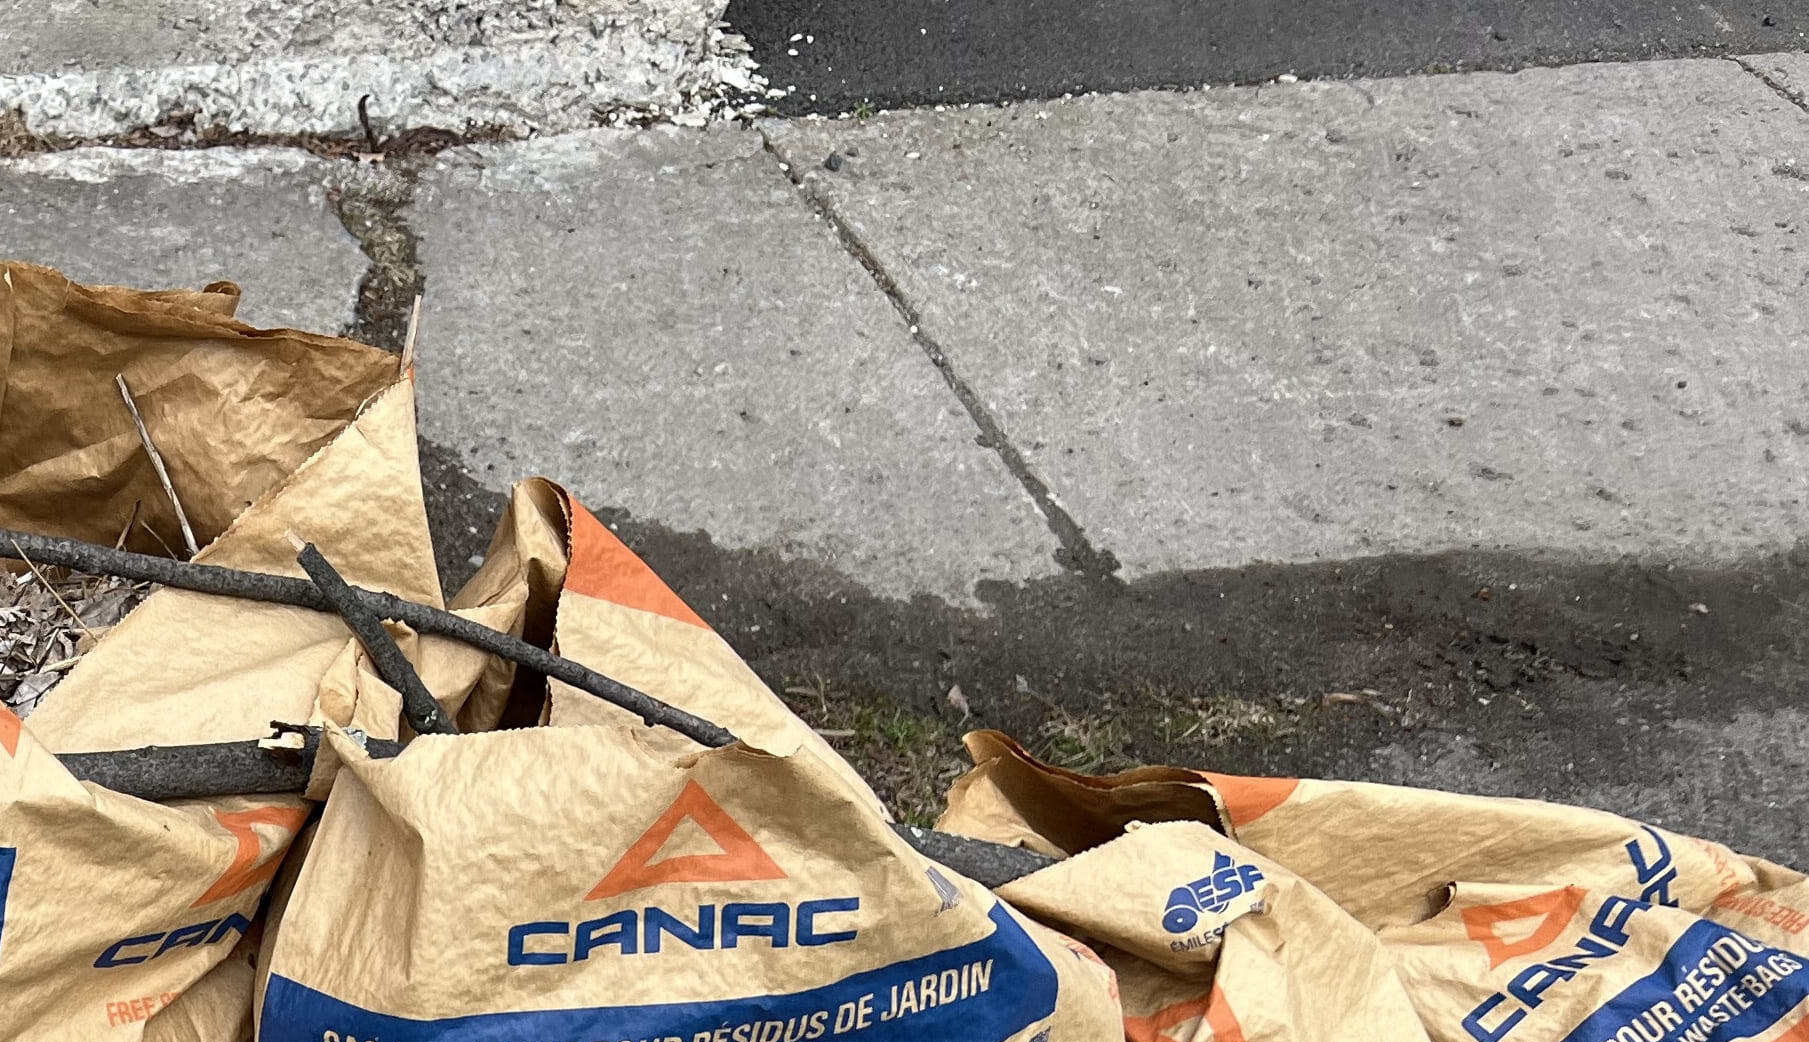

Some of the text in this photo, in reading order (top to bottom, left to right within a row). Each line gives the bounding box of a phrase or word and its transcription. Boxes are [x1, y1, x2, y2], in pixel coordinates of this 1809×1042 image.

[507, 896, 860, 967] CANAC
[833, 993, 875, 1035] DE
[880, 958, 995, 1023] JARDIN
[1672, 931, 1774, 1015] RÉSIDU
[1741, 952, 1805, 1000] BAGS
[105, 996, 158, 1028] FREE
